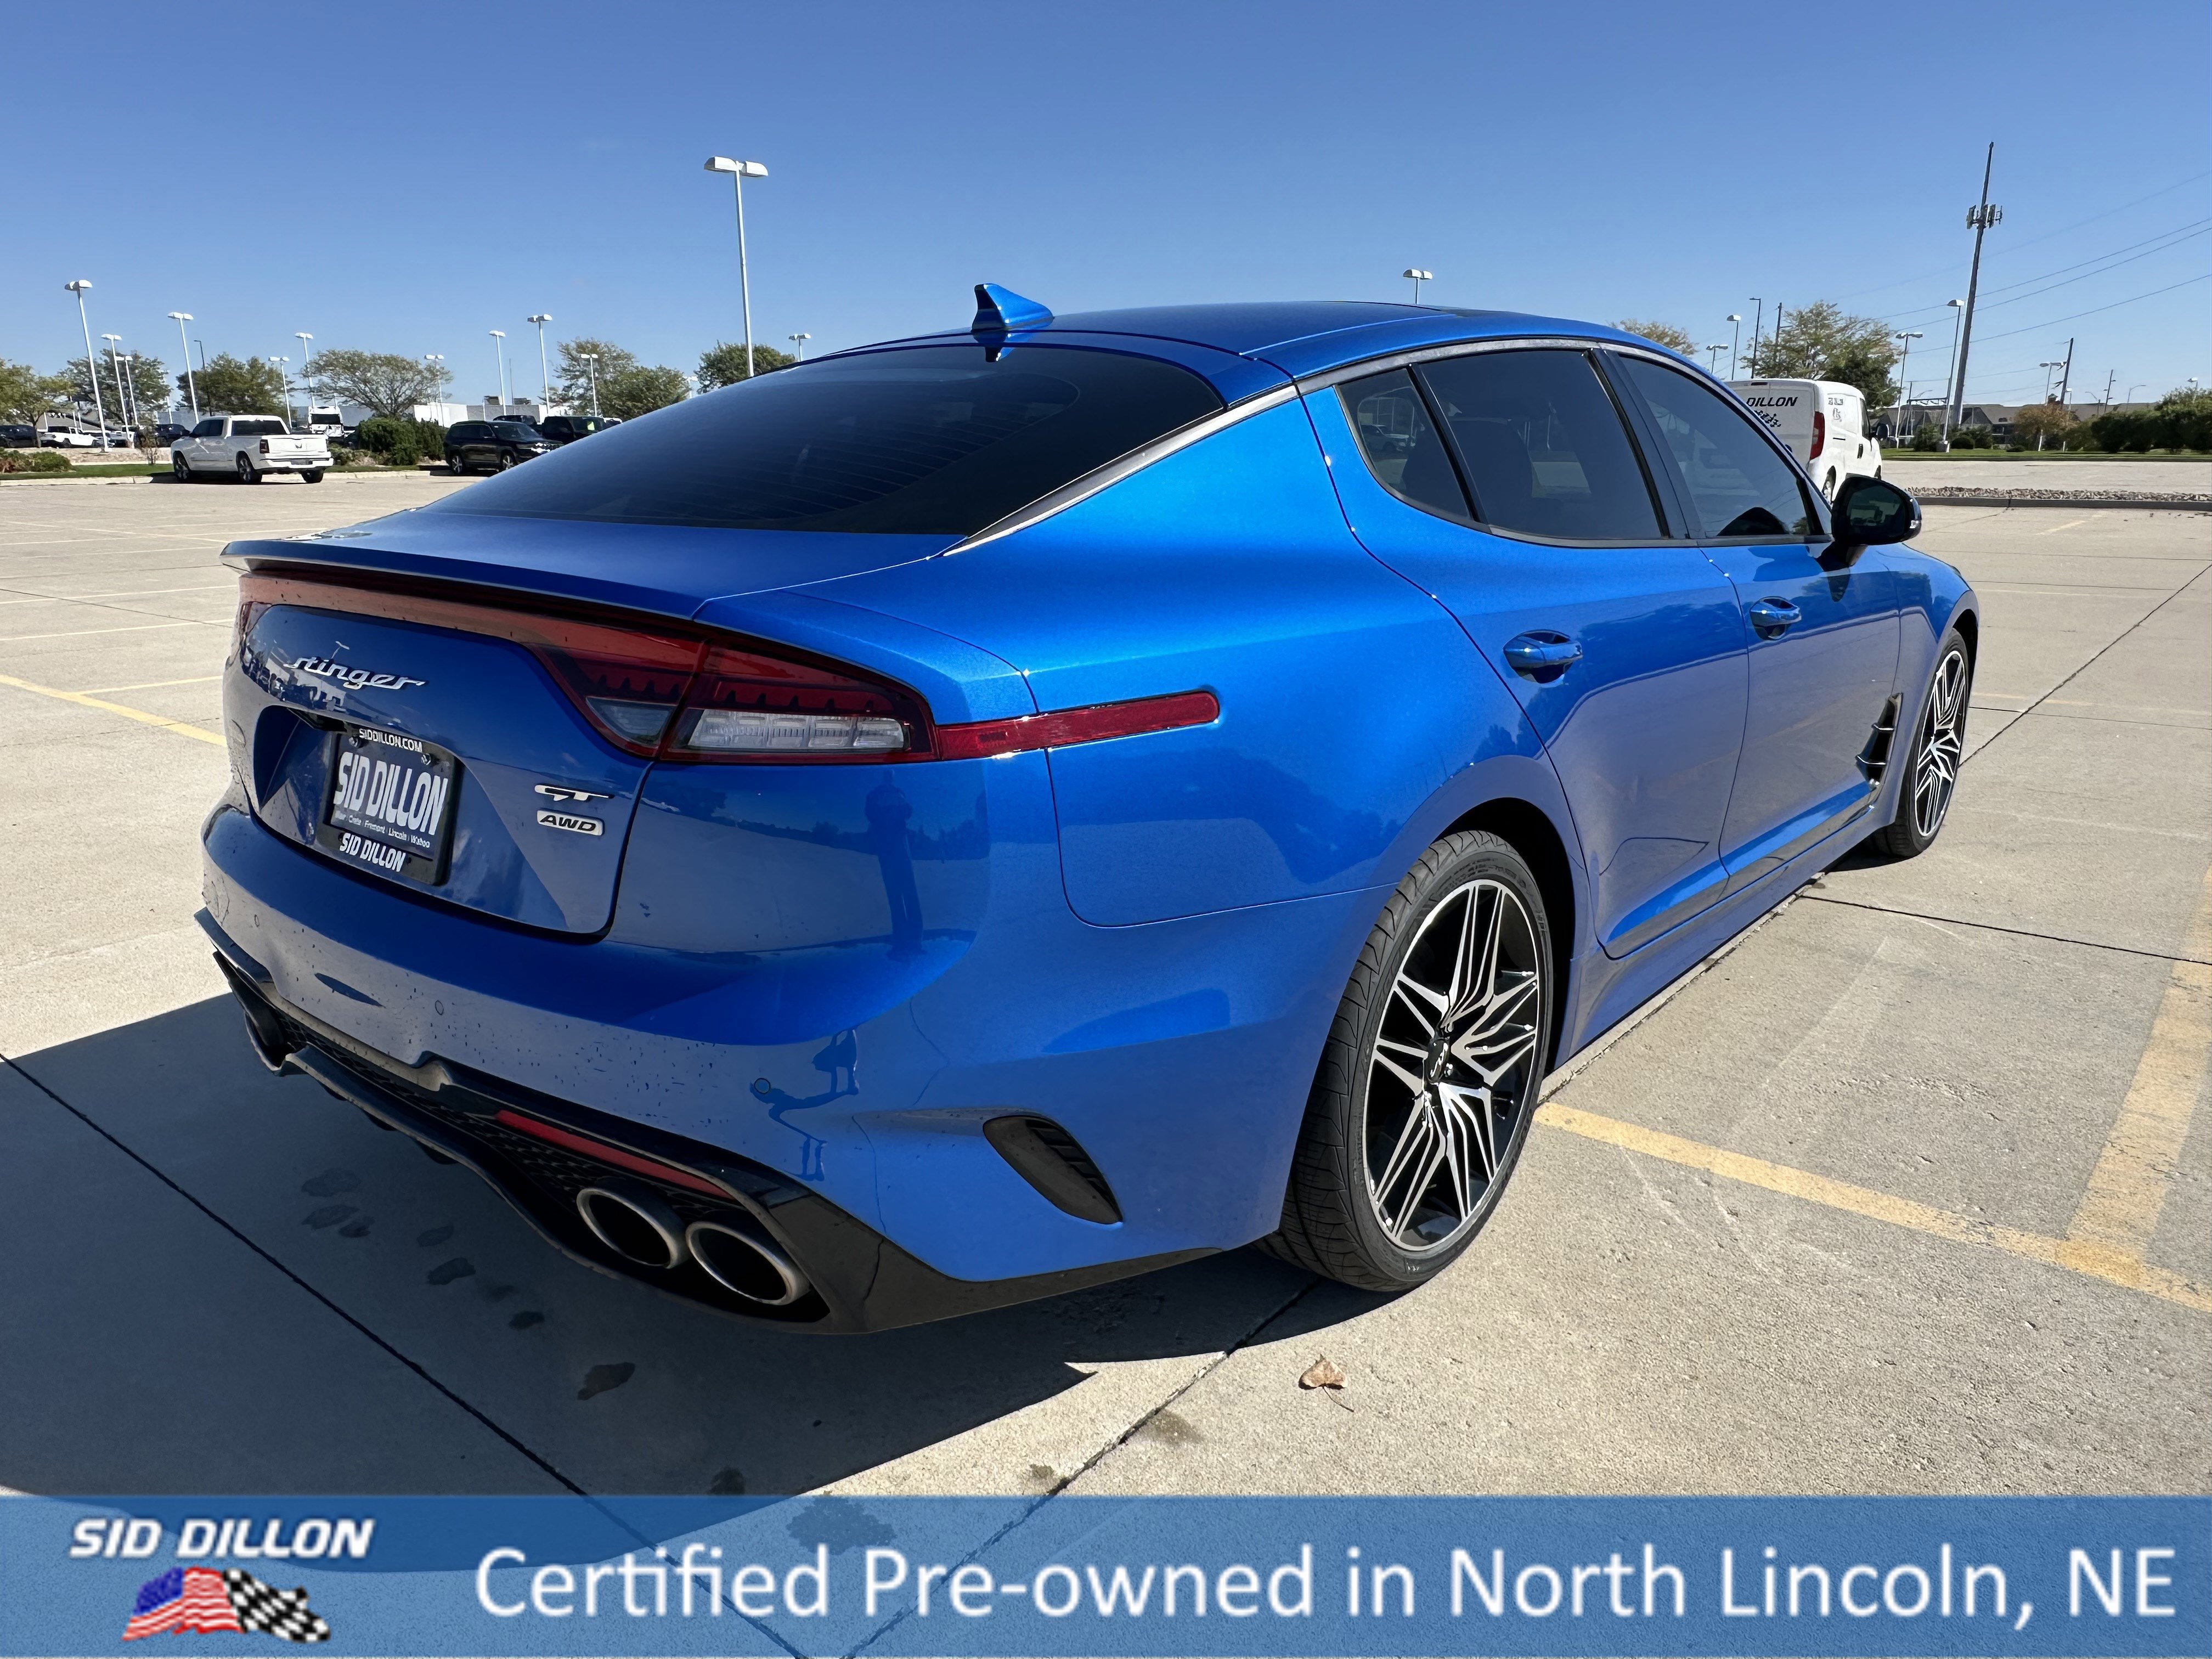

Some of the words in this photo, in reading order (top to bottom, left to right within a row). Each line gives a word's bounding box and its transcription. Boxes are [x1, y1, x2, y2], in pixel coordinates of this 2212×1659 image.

[1746, 397, 1798, 407] DILLON
[359, 728, 423, 753] SIDDILLON.COM
[333, 752, 370, 811] SID
[365, 760, 449, 836] DILLON
[540, 815, 596, 832] AWD
[339, 832, 362, 856] SID
[359, 839, 407, 872] DILLON
